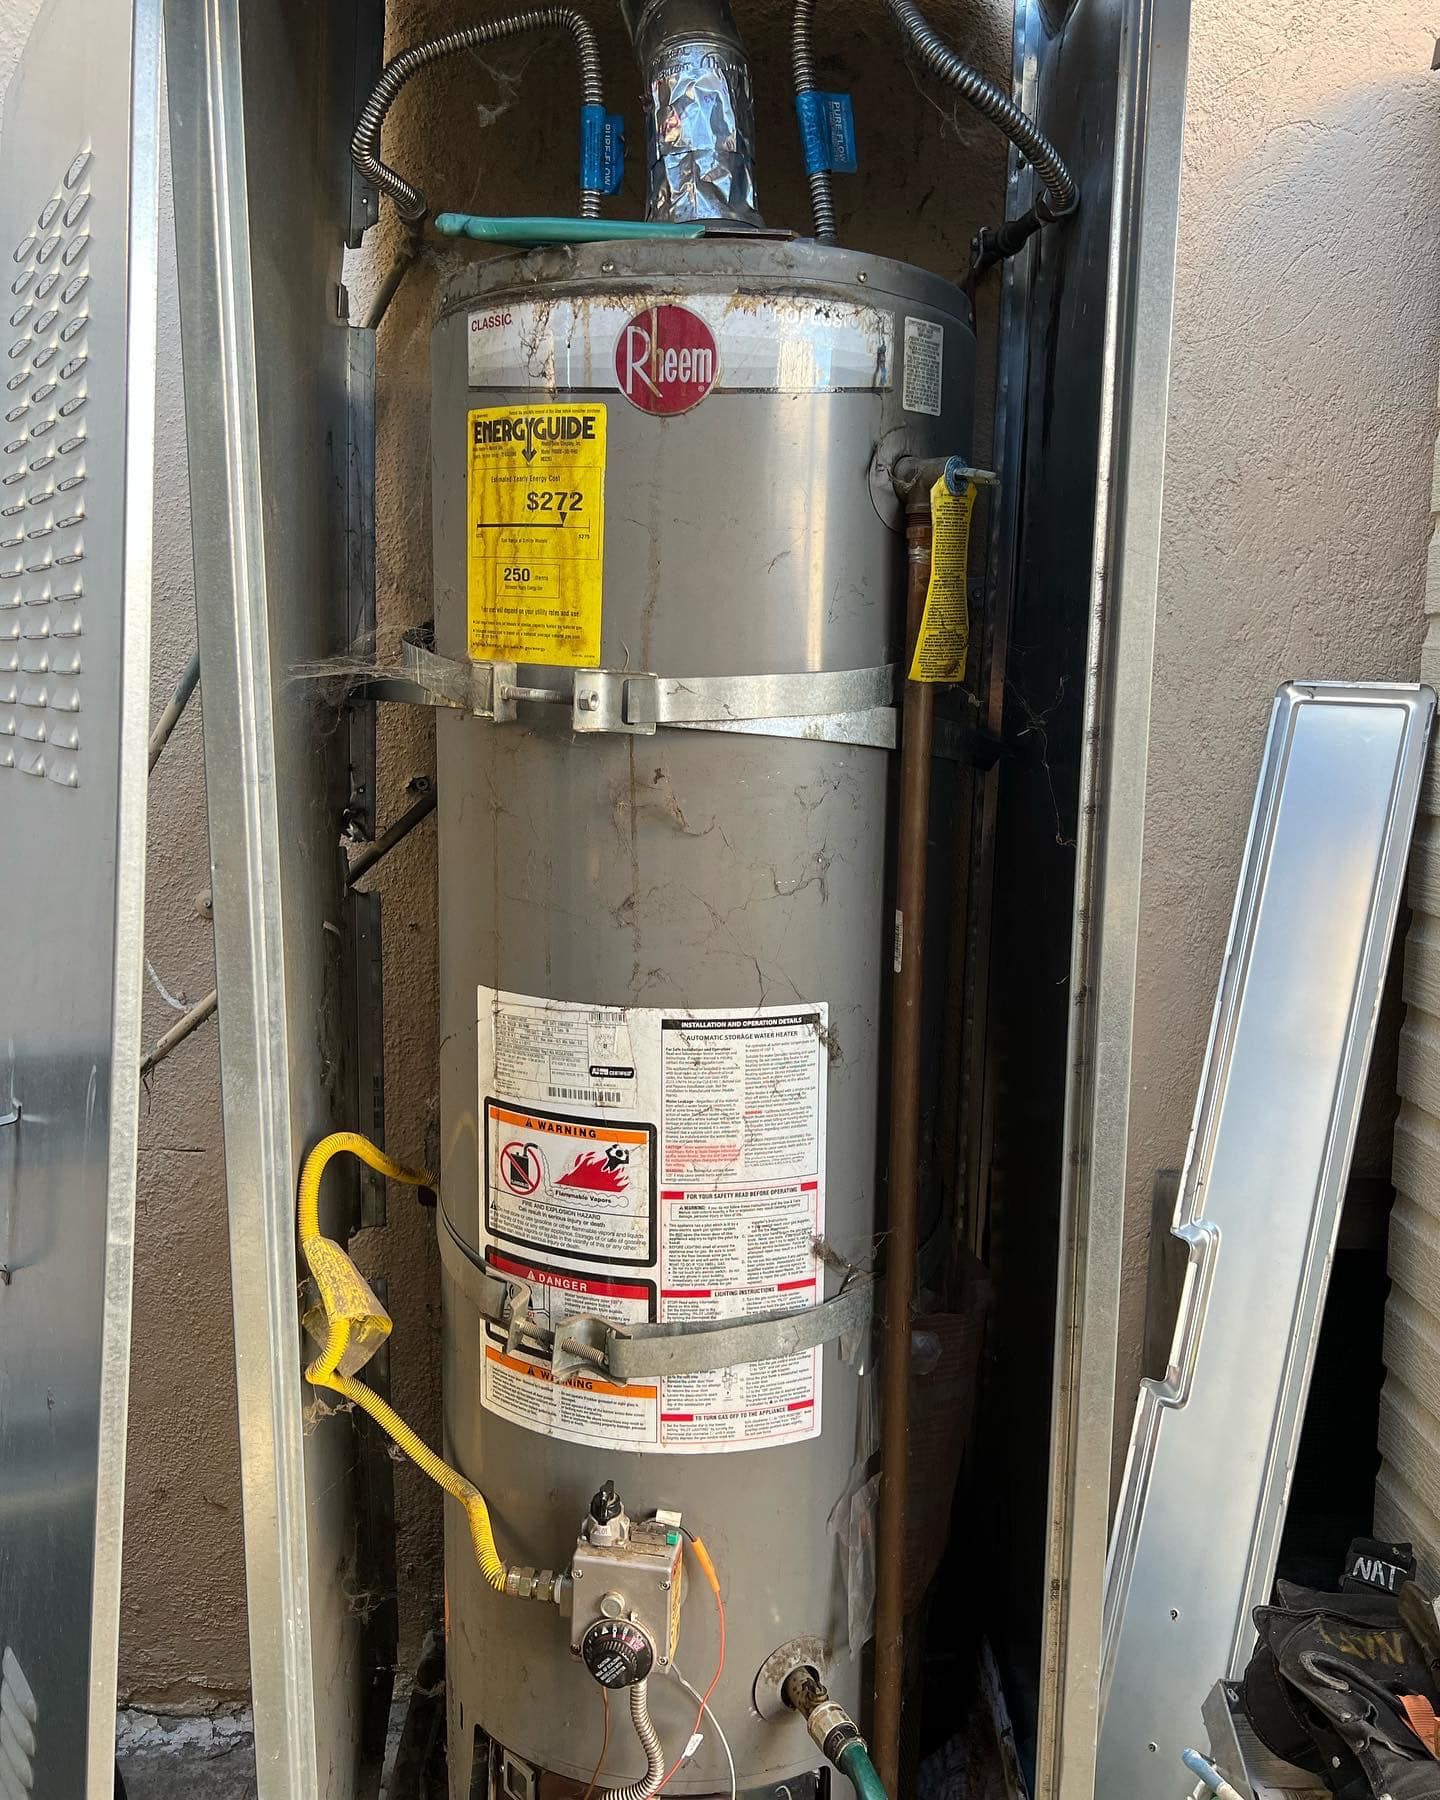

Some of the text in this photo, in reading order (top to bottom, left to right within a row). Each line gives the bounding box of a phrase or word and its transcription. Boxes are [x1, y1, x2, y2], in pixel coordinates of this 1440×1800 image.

[471, 313, 512, 332] CLASSIC
[627, 307, 712, 398] Rheem
[474, 416, 596, 444] ENERGYGUIDE
[529, 474, 547, 483] Energy
[526, 490, 584, 512] $272
[504, 567, 530, 582] 250
[742, 1018, 777, 1027] OPERATION
[724, 1032, 753, 1040] STORAGE
[538, 1121, 596, 1138] WARNING
[555, 1190, 612, 1204] Flammable Vapors
[770, 1187, 798, 1195] OPERATING
[546, 1205, 576, 1216] EXPLOSION
[577, 1212, 600, 1220] HAZARD
[567, 1217, 581, 1225] injury
[538, 1273, 588, 1292] DANGER
[739, 1287, 774, 1296] INSTRUCTIONS
[759, 1408, 786, 1417] APPLIANCE
[1352, 1556, 1408, 1590] NAT
